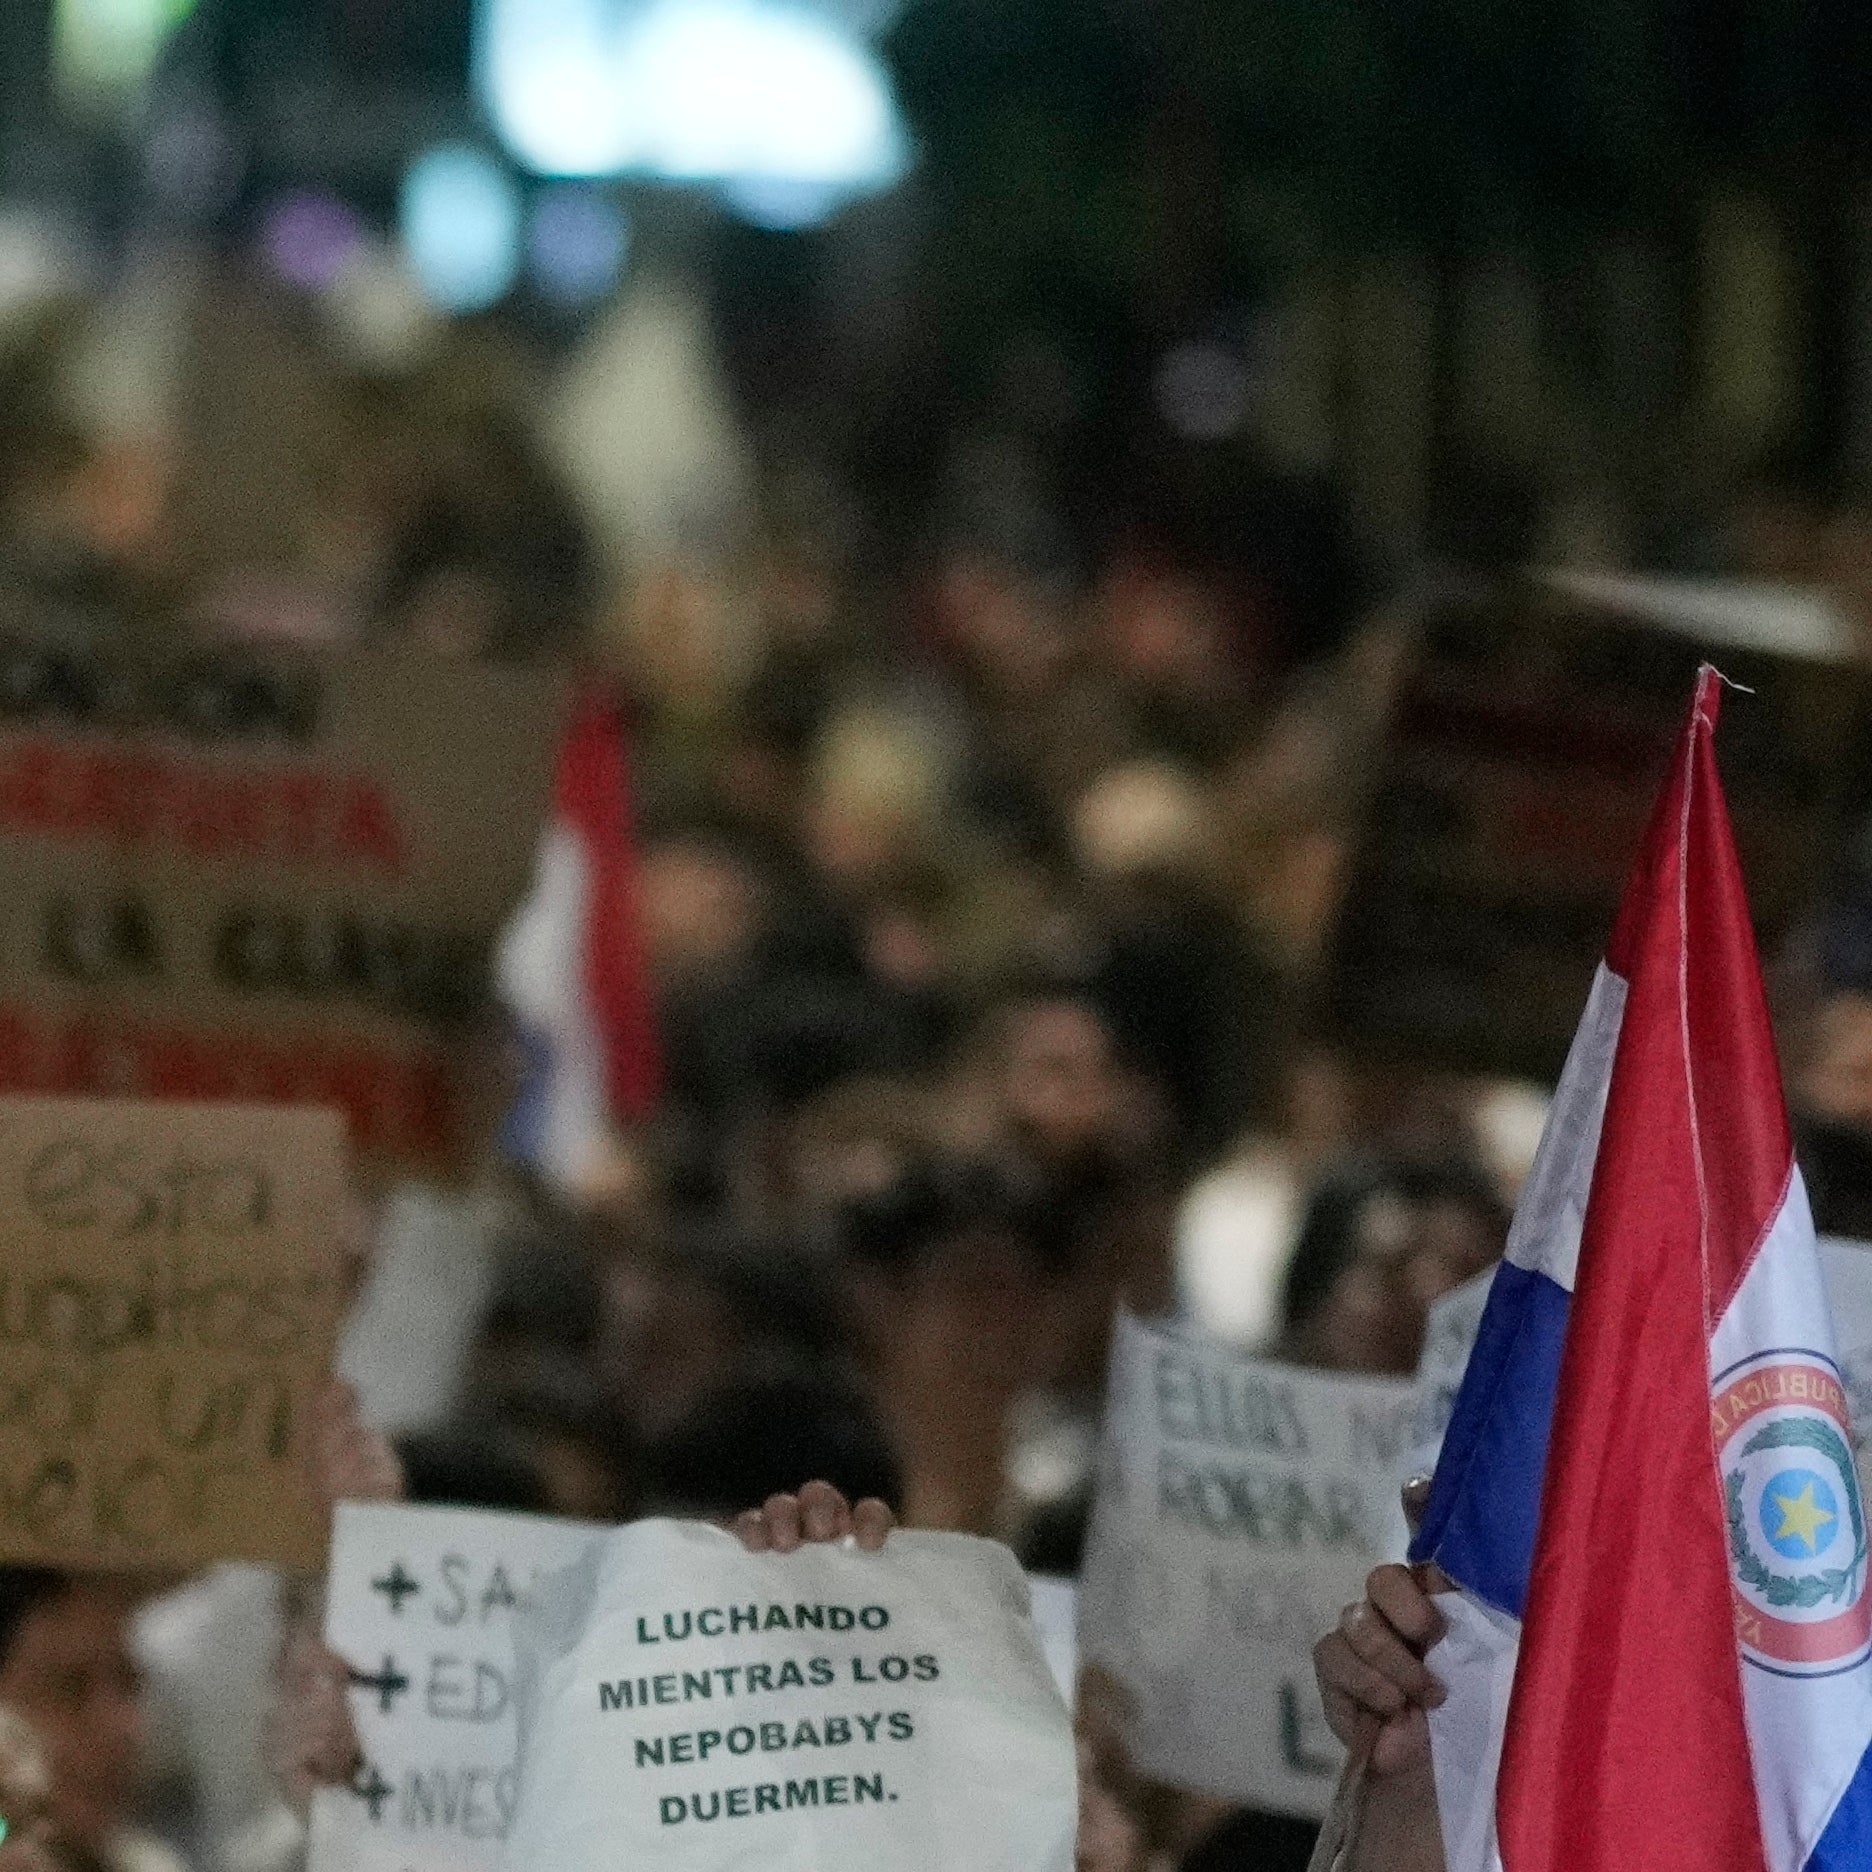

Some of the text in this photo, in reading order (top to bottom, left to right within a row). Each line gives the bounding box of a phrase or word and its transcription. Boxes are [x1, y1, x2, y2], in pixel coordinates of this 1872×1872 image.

[635, 1604, 890, 1646] LUCHANDO
[598, 1652, 941, 1712] MIENTRAS LOS
[633, 1709, 915, 1769] NEPOBABYS
[658, 1772, 900, 1828] DUERMEN.
